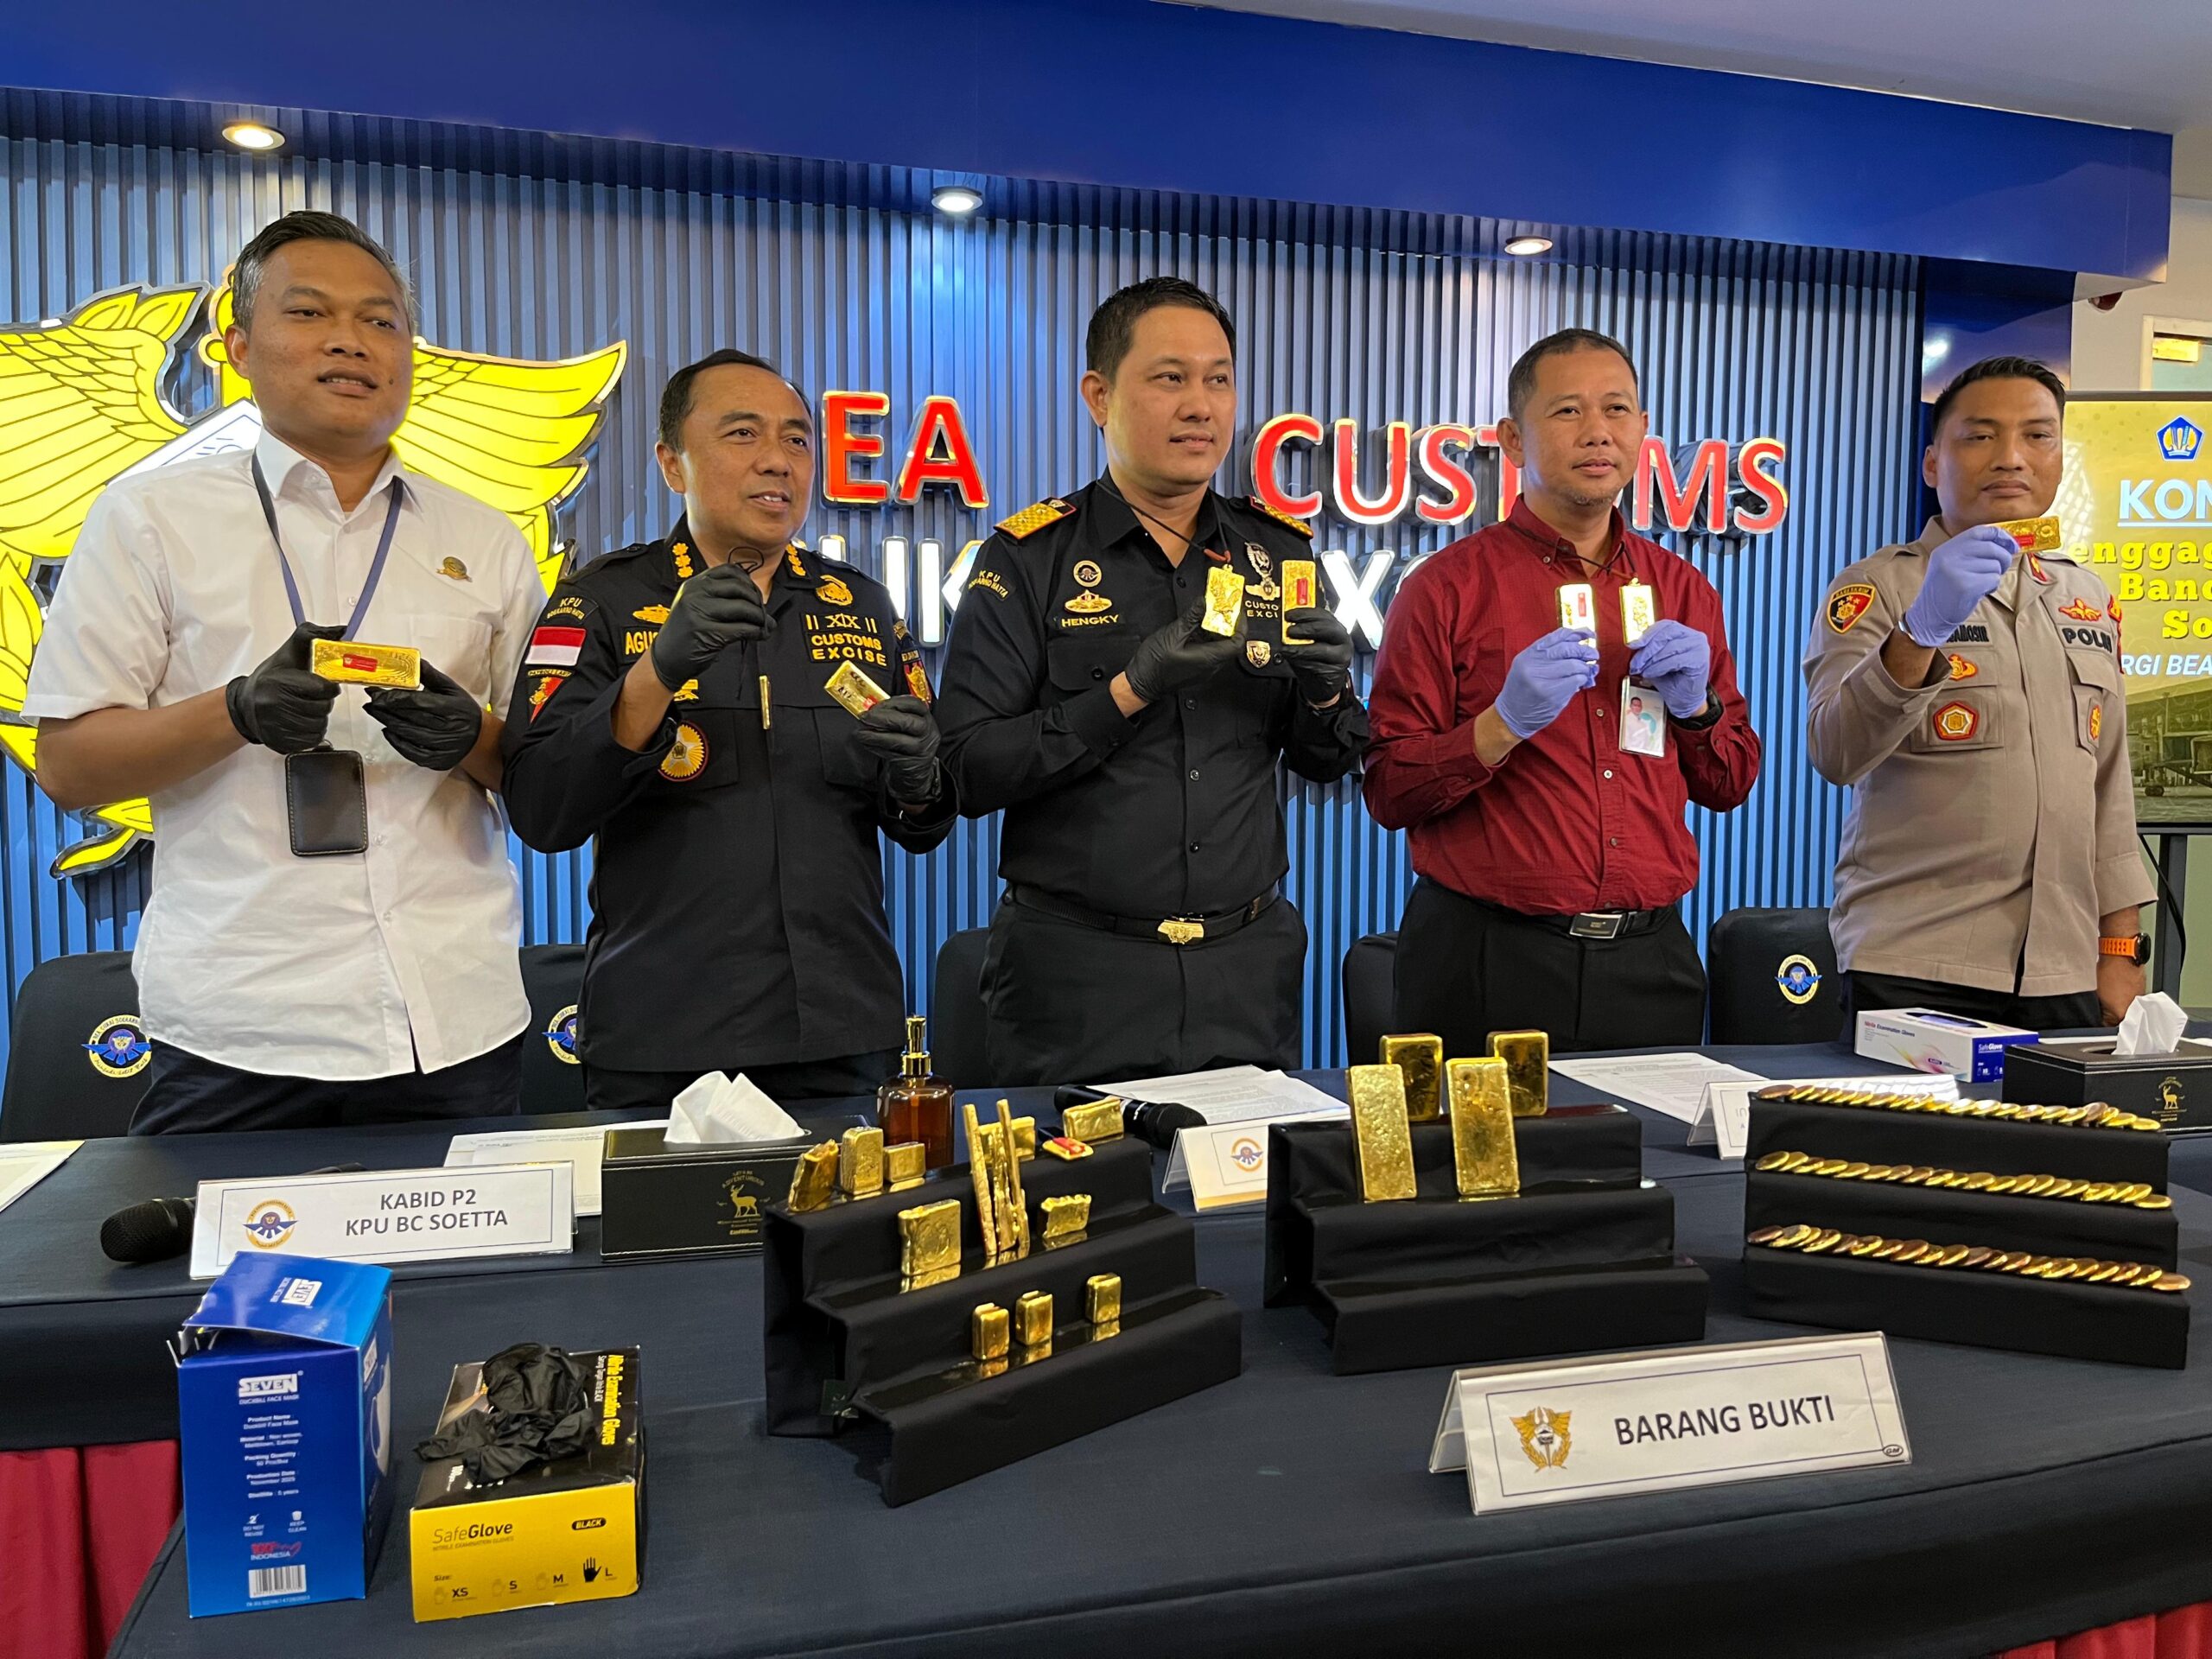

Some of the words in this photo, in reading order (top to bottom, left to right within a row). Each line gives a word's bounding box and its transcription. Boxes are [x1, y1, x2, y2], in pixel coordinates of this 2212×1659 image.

[823, 391, 989, 508] EA
[1250, 413, 1789, 534] CUSTMS
[979, 570, 1001, 582] KPU
[559, 597, 582, 607] KPU
[1245, 600, 1279, 611] CUSTO
[1061, 614, 1119, 628] HENGKY
[811, 632, 882, 651] CUSTOMS
[812, 647, 887, 667] EXCISE
[2120, 654, 2160, 677] RGI
[380, 1192, 445, 1211] KABID
[452, 1189, 477, 1206] P2
[346, 1217, 389, 1236] KPU
[396, 1215, 423, 1233] BC
[429, 1210, 508, 1230] SOETTA
[238, 1373, 298, 1398] SEVEN
[1614, 1405, 1740, 1446] BARANG
[1748, 1395, 1835, 1431] BUKTI
[575, 1518, 602, 1529] BLACK
[432, 1523, 513, 1544] SafeGlove
[509, 1580, 518, 1590] S
[553, 1573, 563, 1584] M
[452, 1587, 468, 1598] XS
